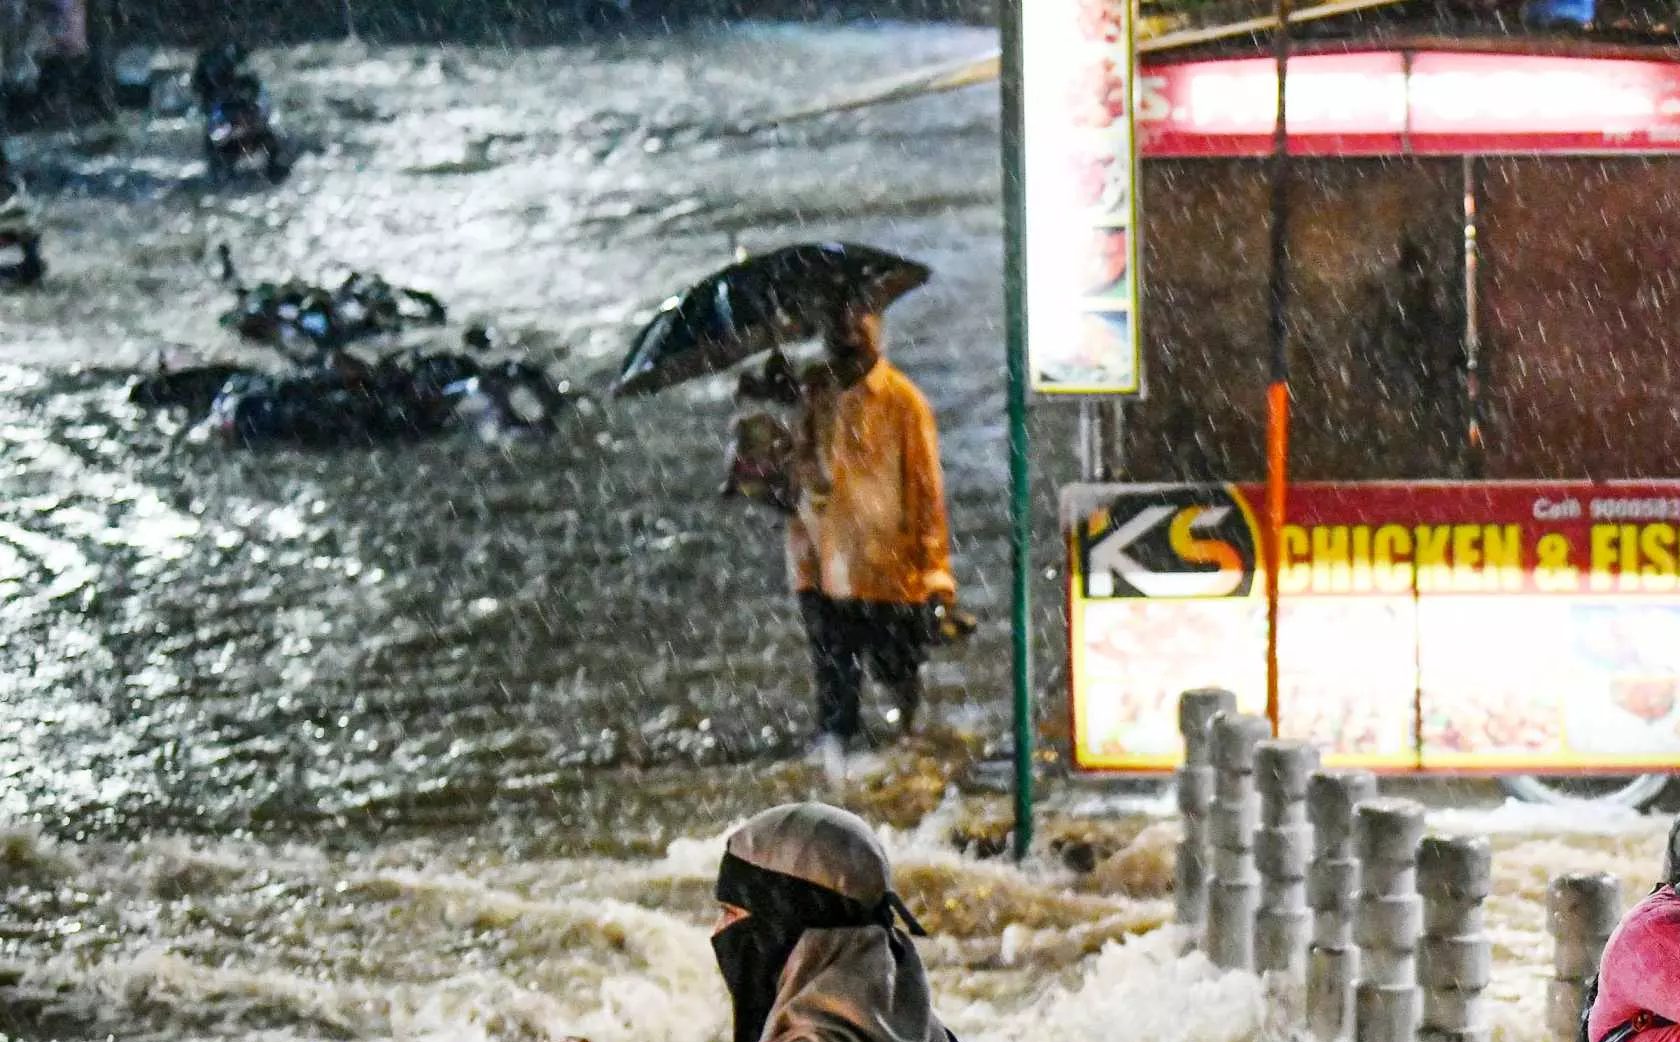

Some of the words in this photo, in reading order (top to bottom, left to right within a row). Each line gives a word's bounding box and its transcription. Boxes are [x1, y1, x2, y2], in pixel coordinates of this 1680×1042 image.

[1088, 504, 1244, 597] KS
[1277, 522, 1524, 594] CHICKEN
[1533, 531, 1580, 592] &
